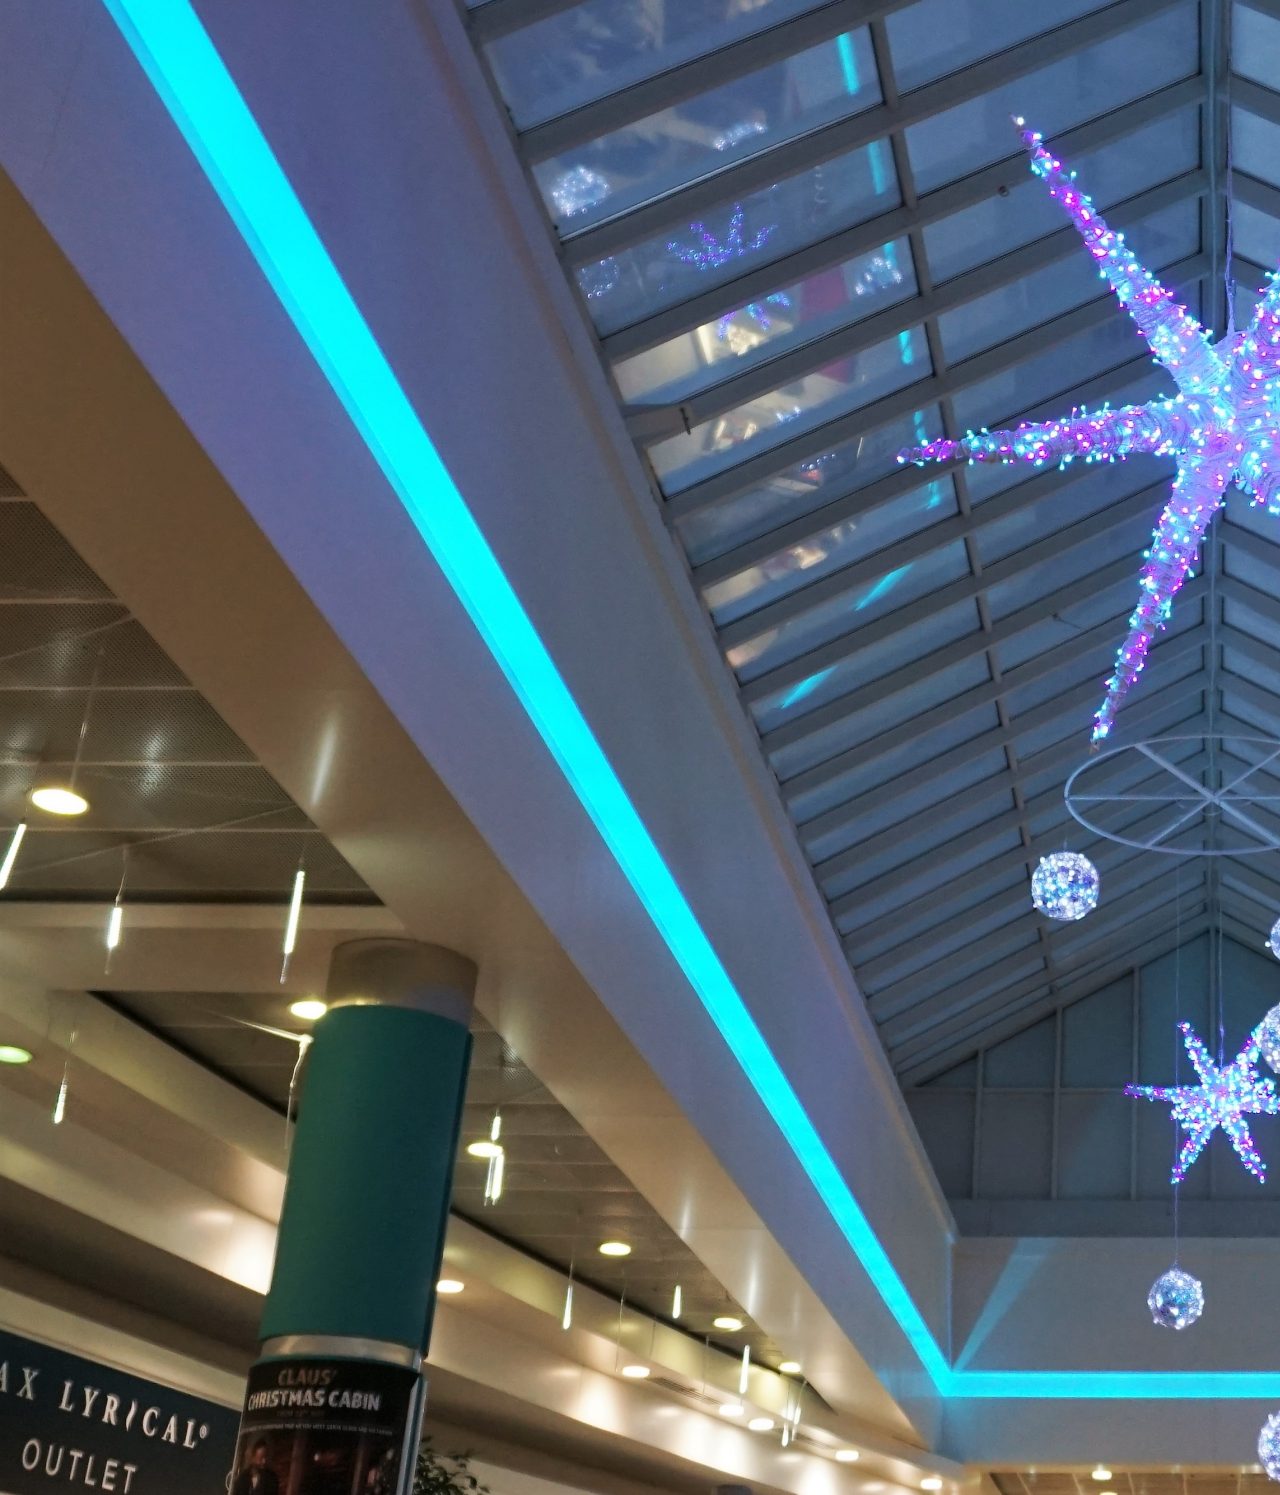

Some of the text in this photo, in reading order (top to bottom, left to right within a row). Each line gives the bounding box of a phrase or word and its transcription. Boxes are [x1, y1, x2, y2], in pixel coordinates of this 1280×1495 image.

[248, 1389, 380, 1411] CHRISTMAS CABIN
[22, 1438, 137, 1494] OUTLET
